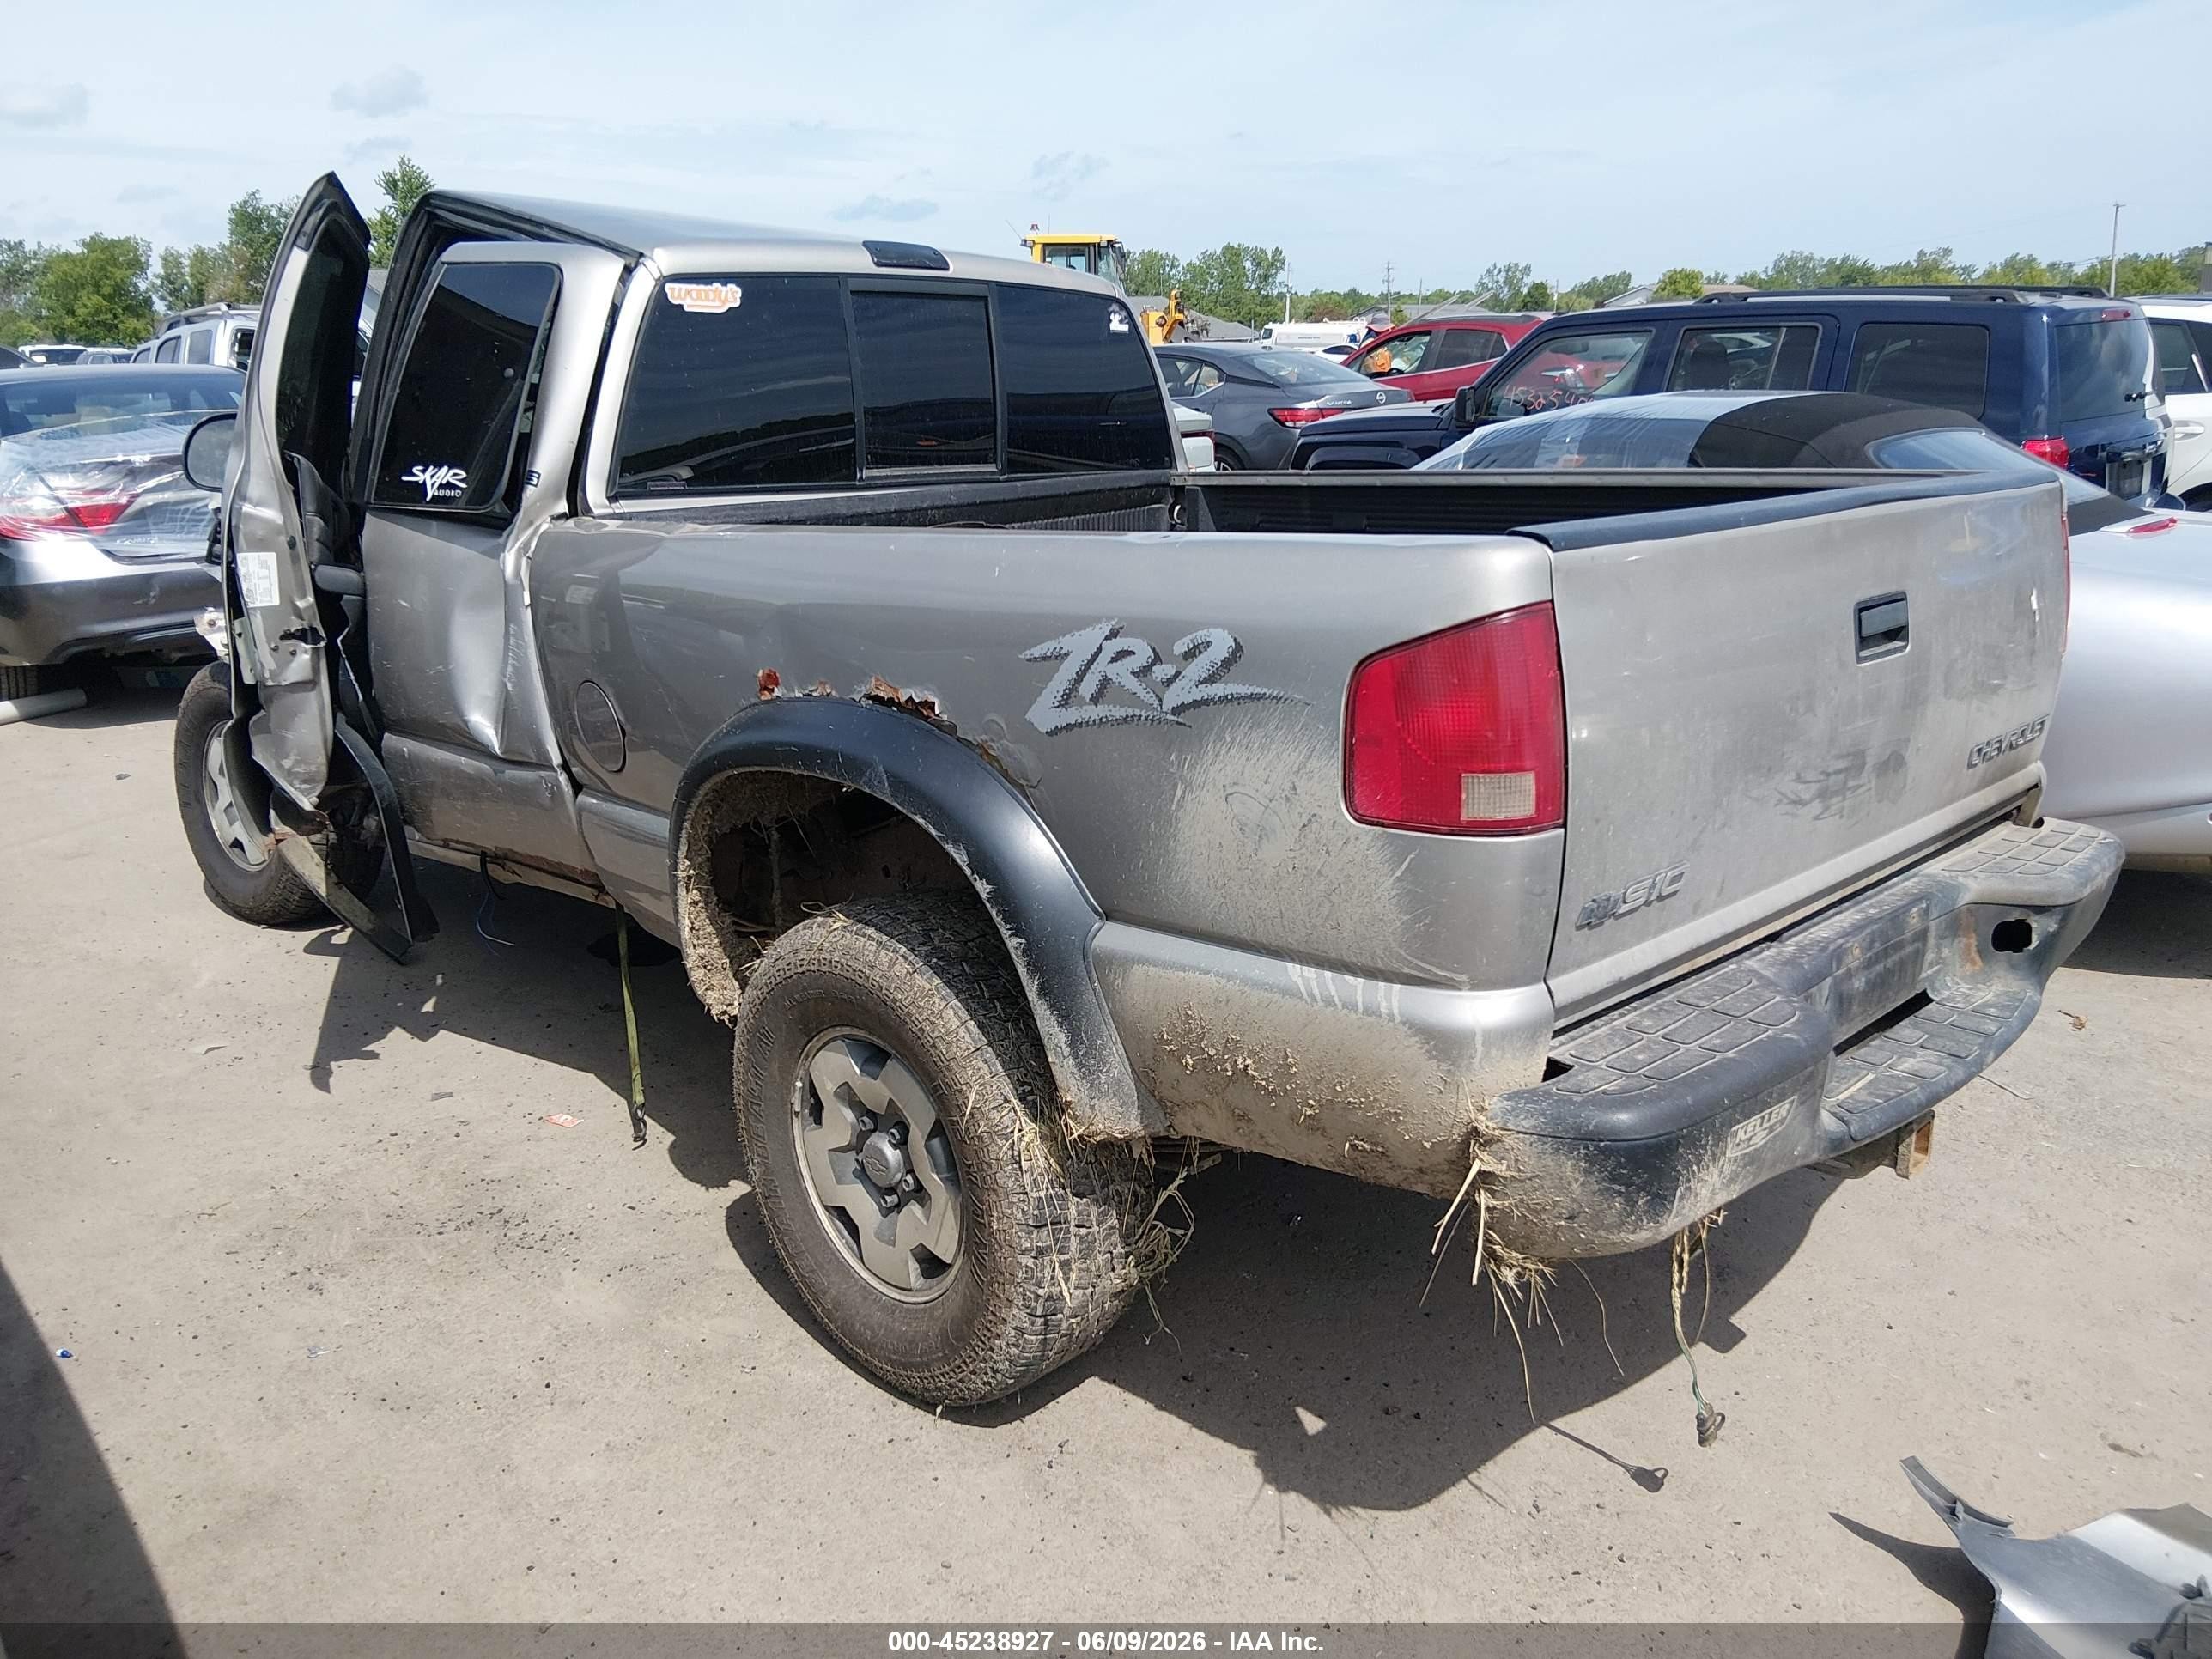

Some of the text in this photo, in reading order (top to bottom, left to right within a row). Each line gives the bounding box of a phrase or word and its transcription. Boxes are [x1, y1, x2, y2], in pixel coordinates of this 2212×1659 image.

[401, 465, 468, 502] SKAR
[433, 489, 462, 497] AUDIO
[1735, 1103, 1791, 1144] KELLER
